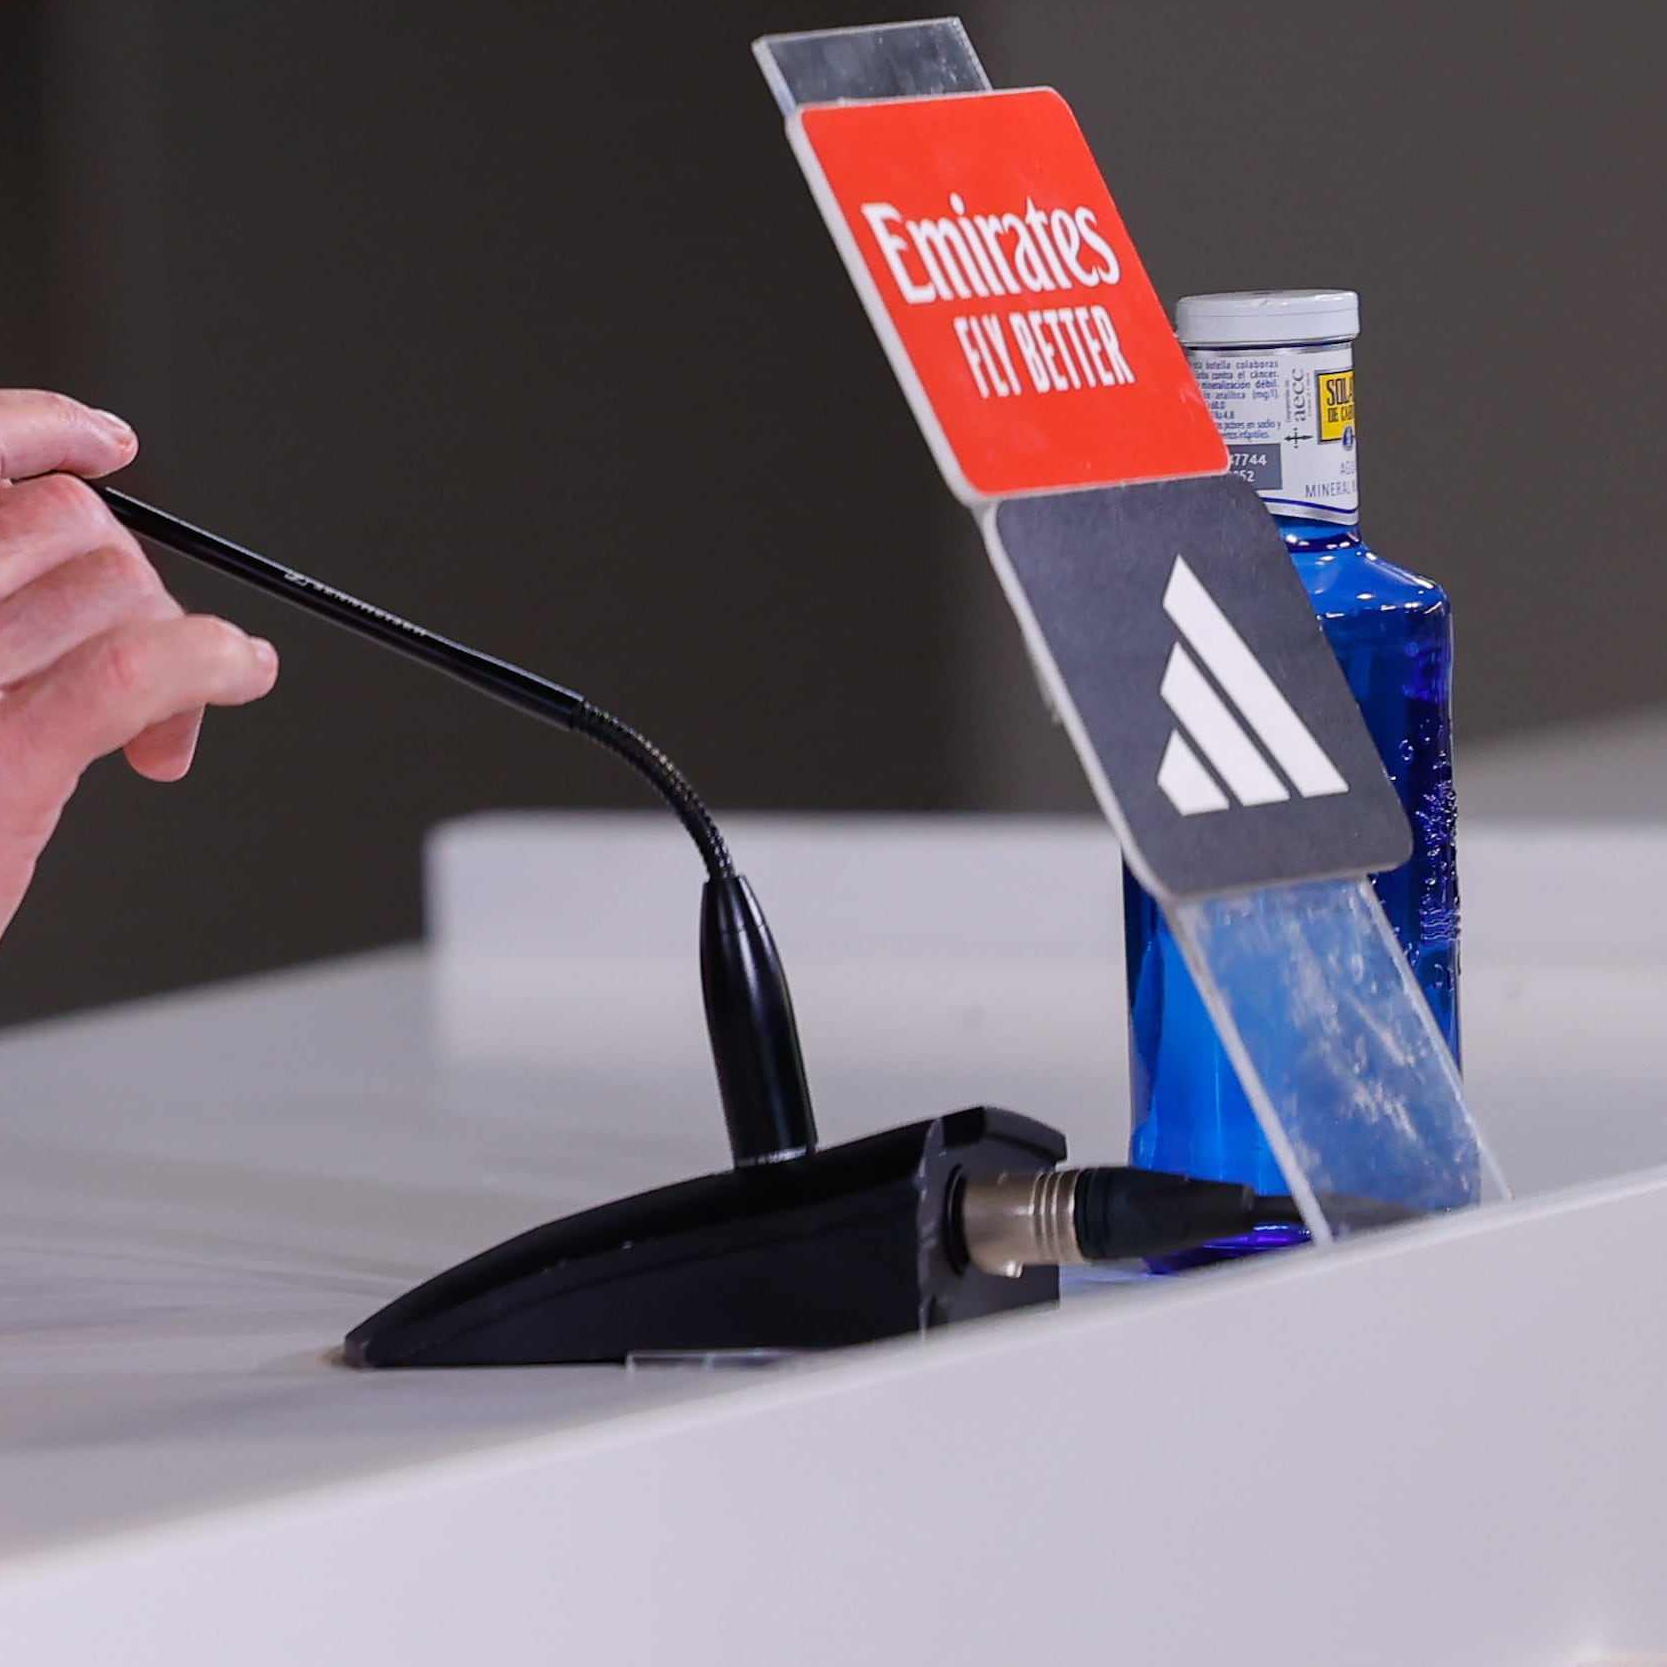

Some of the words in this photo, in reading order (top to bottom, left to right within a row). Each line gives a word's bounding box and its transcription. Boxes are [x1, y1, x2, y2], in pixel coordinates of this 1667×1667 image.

[860, 192, 1121, 304] Emirates
[953, 313, 1022, 399] FLY
[1008, 305, 1135, 393] BETTER
[1236, 360, 1279, 369] colaboras
[1238, 370, 1246, 380] el
